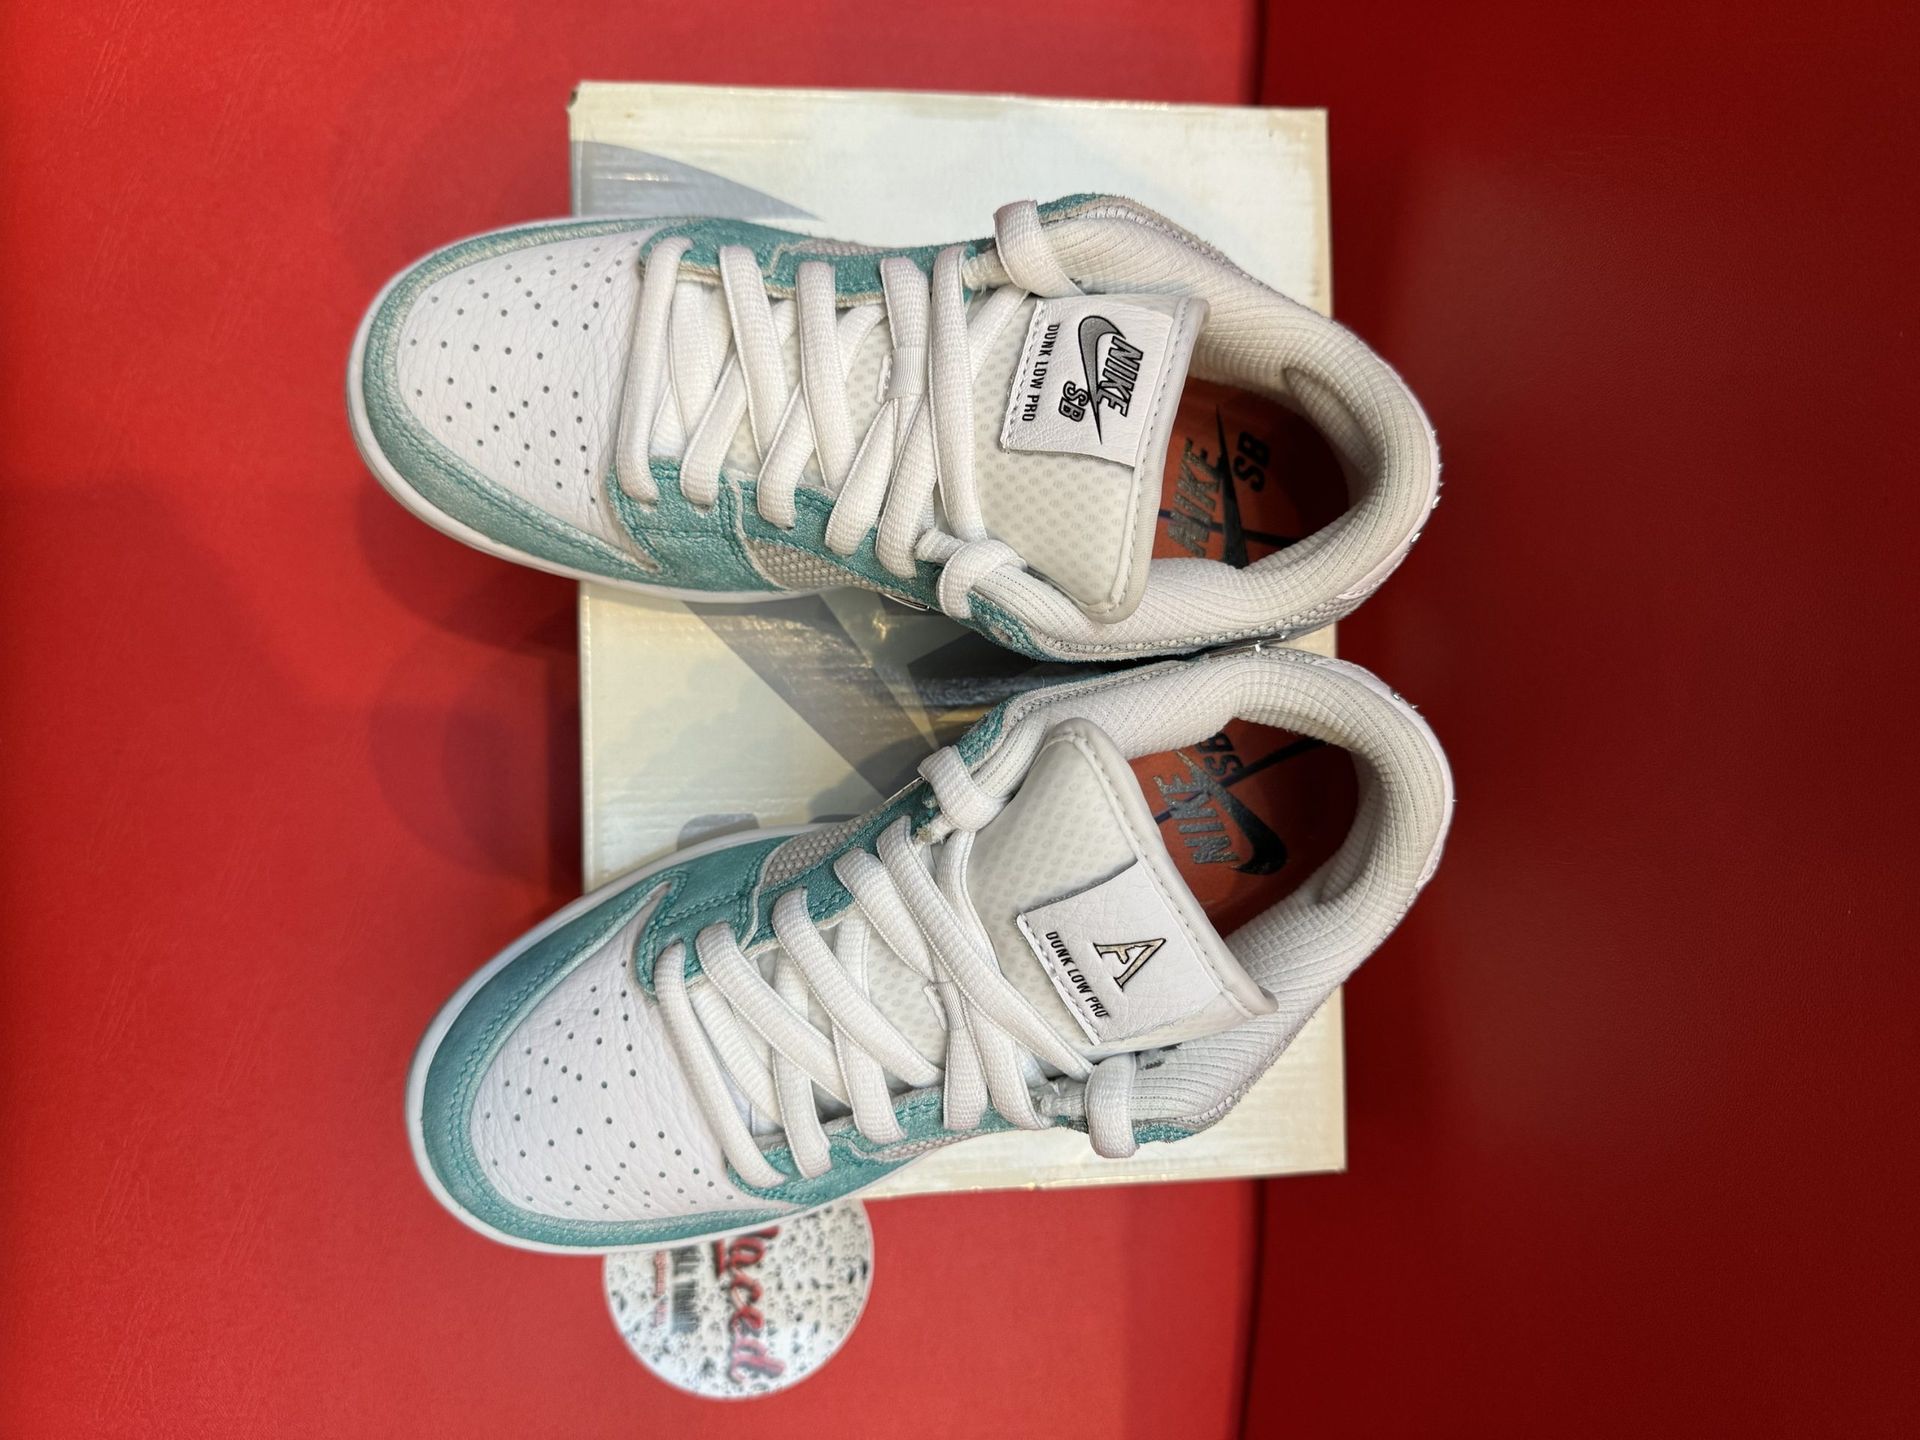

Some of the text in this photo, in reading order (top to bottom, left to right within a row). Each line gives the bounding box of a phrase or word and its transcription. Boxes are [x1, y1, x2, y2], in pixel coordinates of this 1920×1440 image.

[1021, 323, 1061, 422] DUNK LOW PRO
[1058, 380, 1090, 422] SB
[1097, 335, 1144, 417] NIKE
[1167, 437, 1225, 558] NIKE
[1233, 431, 1273, 492] SB
[1196, 732, 1245, 776] SB
[1152, 766, 1241, 864] NIKE
[1045, 931, 1111, 1019] DUNK LOW PRO
